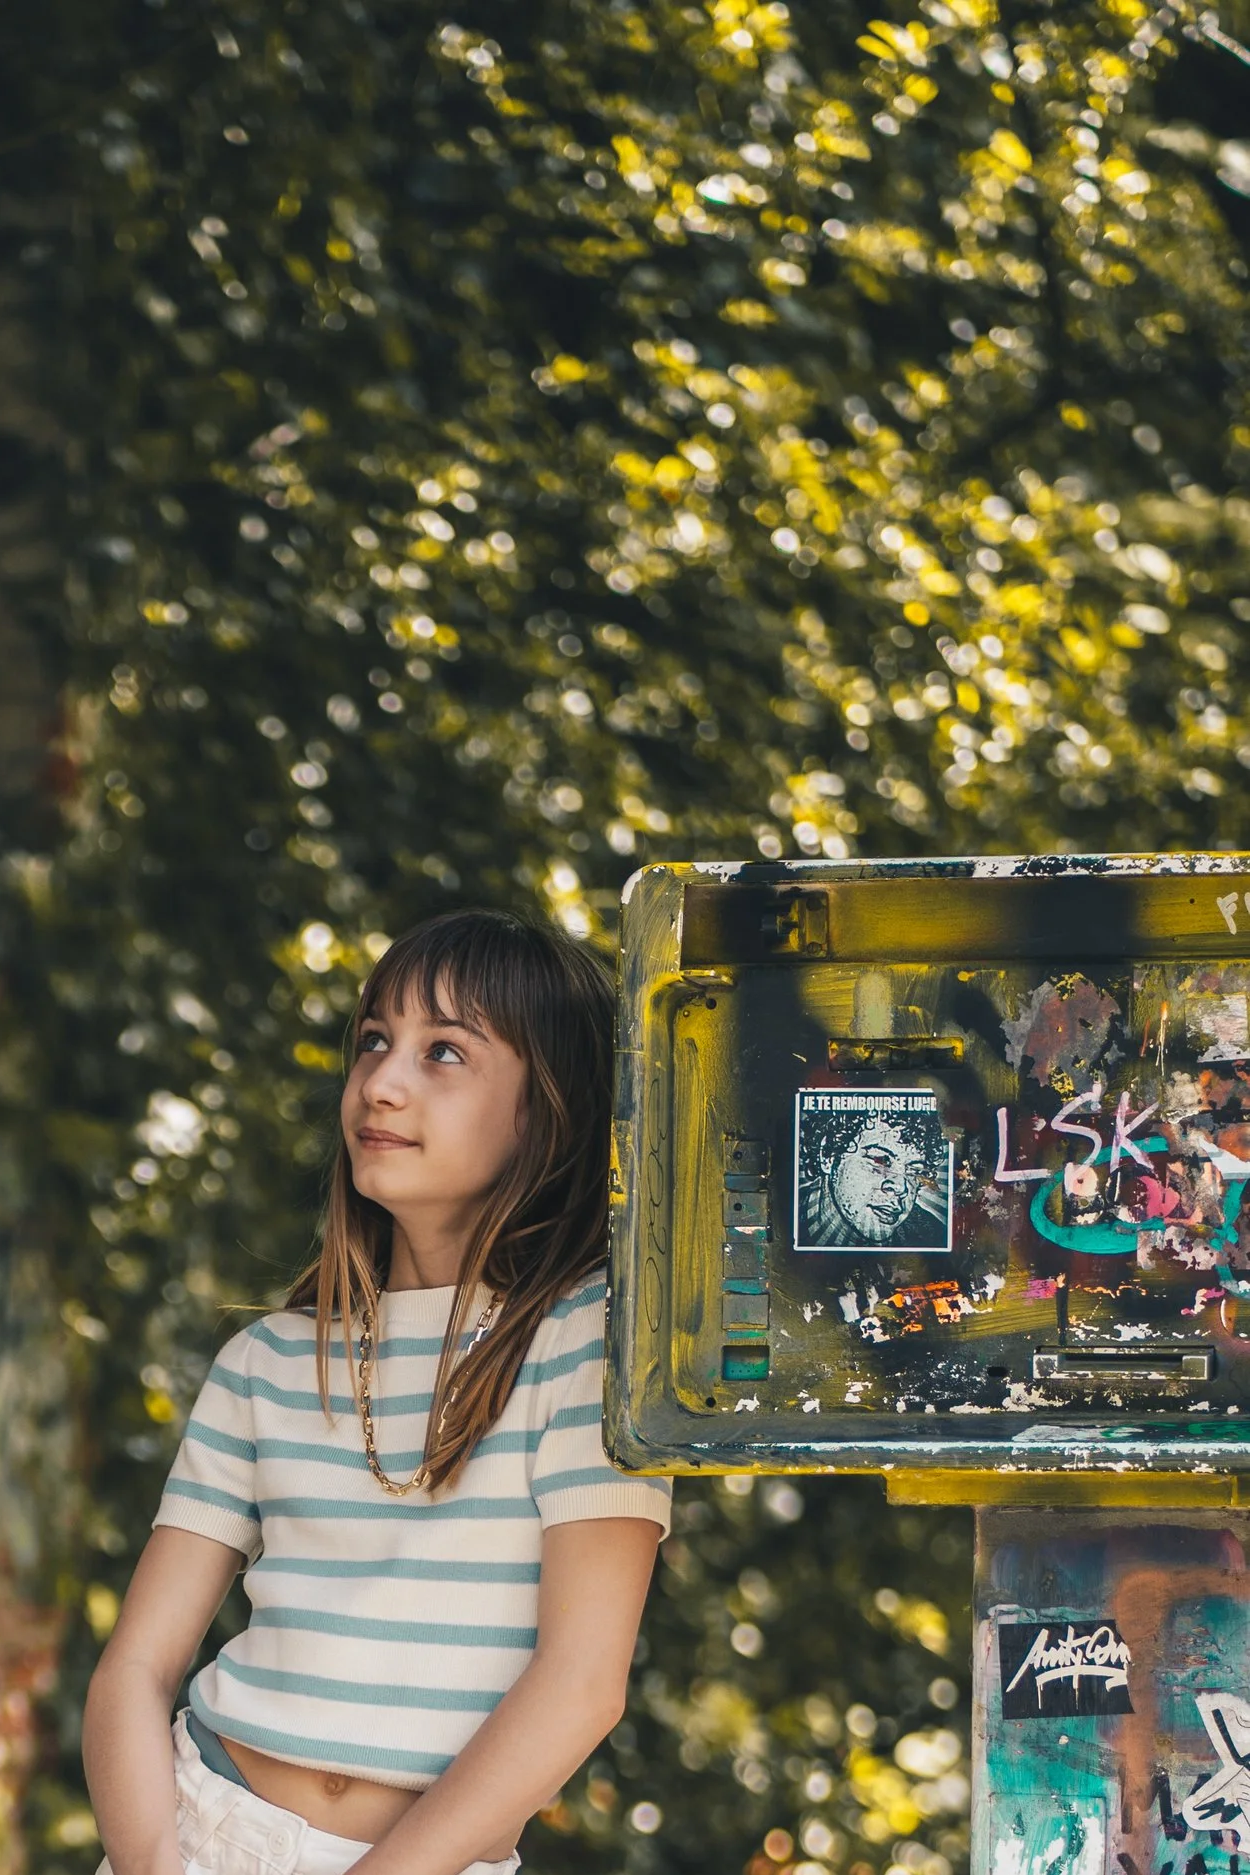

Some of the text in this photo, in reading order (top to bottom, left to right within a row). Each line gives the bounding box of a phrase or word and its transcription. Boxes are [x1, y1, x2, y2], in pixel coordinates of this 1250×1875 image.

[803, 1096, 815, 1110] JE
[817, 1096, 831, 1110] TE
[832, 1096, 906, 1111] REMBOURSE
[994, 1085, 1160, 1184] LSK
